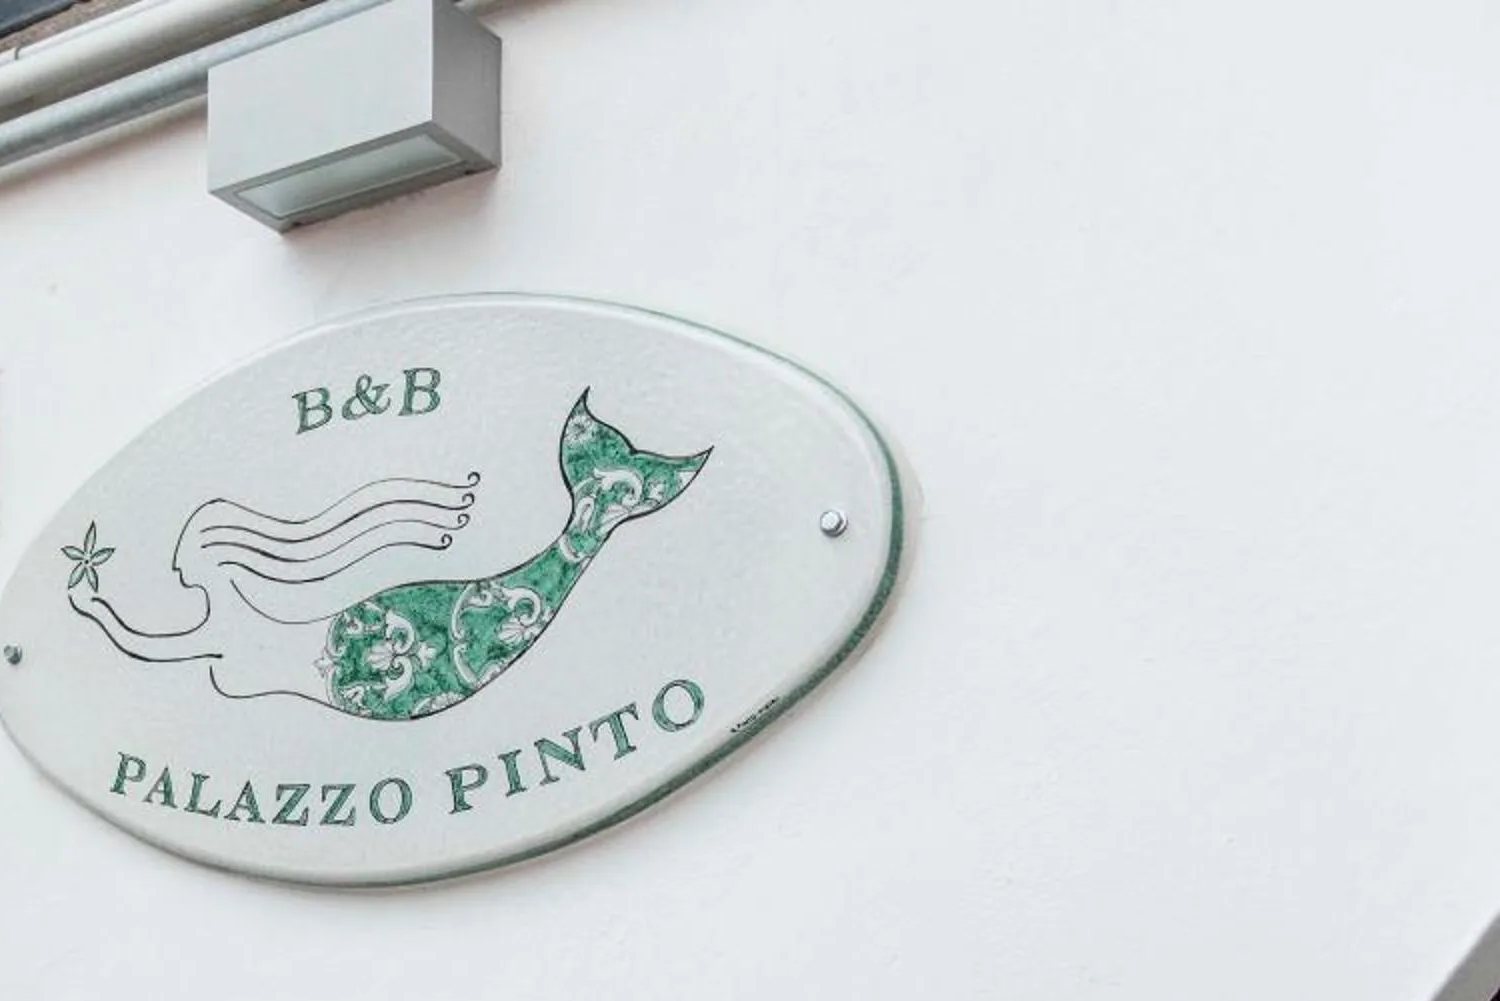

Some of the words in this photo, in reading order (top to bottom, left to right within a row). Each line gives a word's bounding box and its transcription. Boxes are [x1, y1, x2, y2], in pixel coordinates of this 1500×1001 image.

[291, 366, 443, 436] B&B
[109, 751, 413, 827] PALAZZO
[445, 678, 706, 814] PINTO
